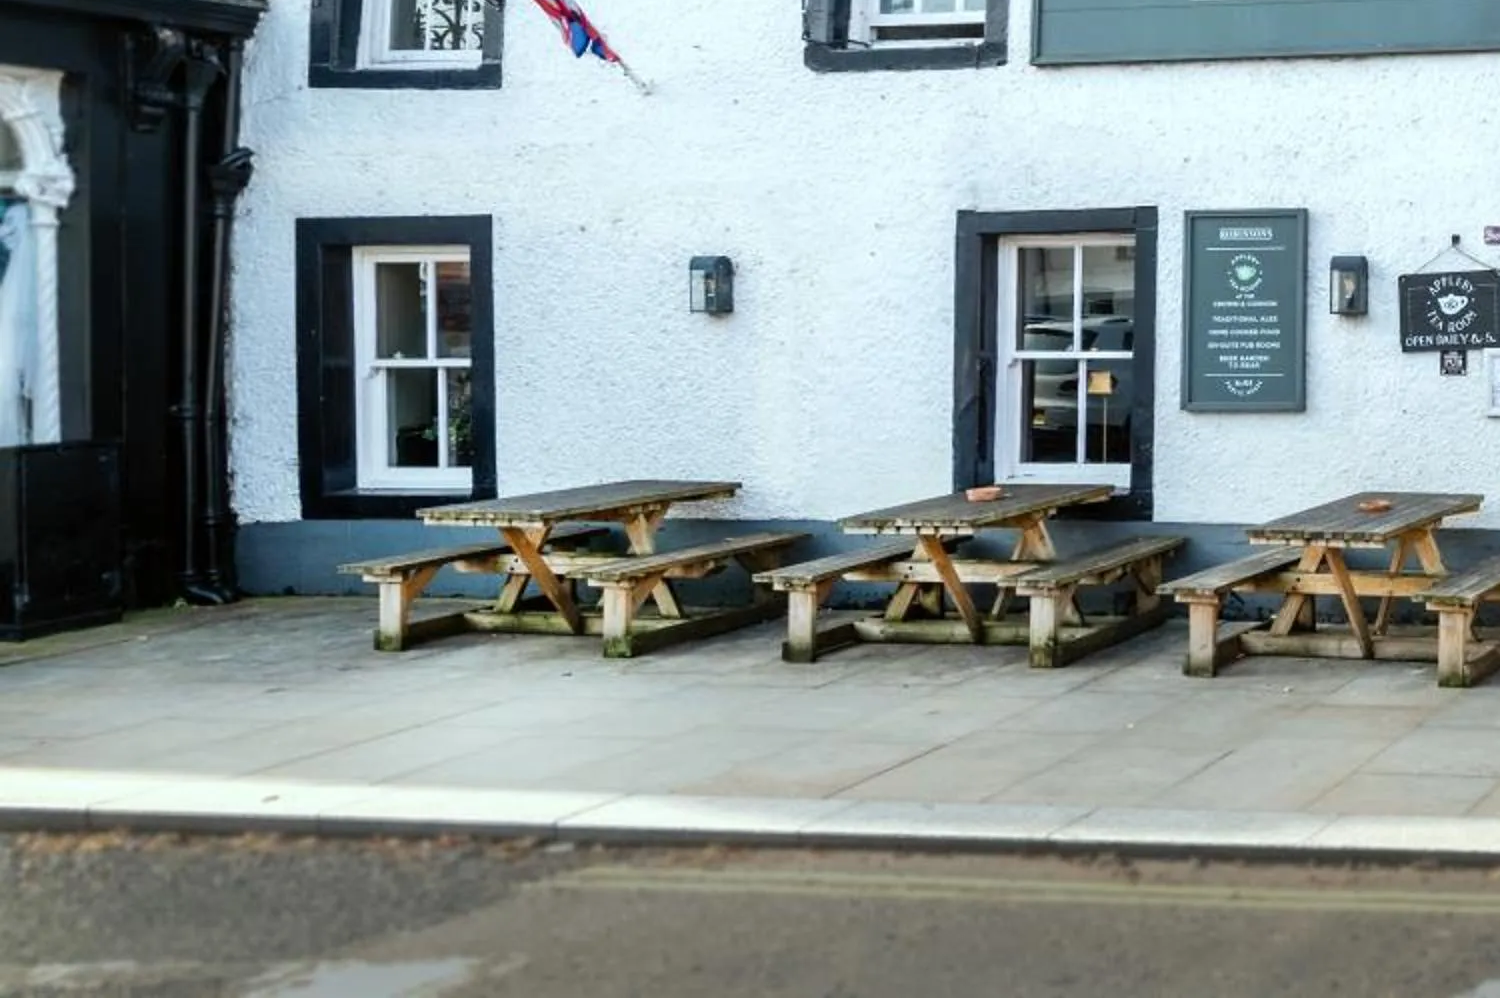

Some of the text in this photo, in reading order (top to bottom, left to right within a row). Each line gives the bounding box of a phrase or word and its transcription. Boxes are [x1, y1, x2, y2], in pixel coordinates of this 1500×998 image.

[1429, 275, 1473, 296] APPLEBY
[1427, 310, 1443, 331] TEA
[1405, 335, 1433, 347] OPEN
